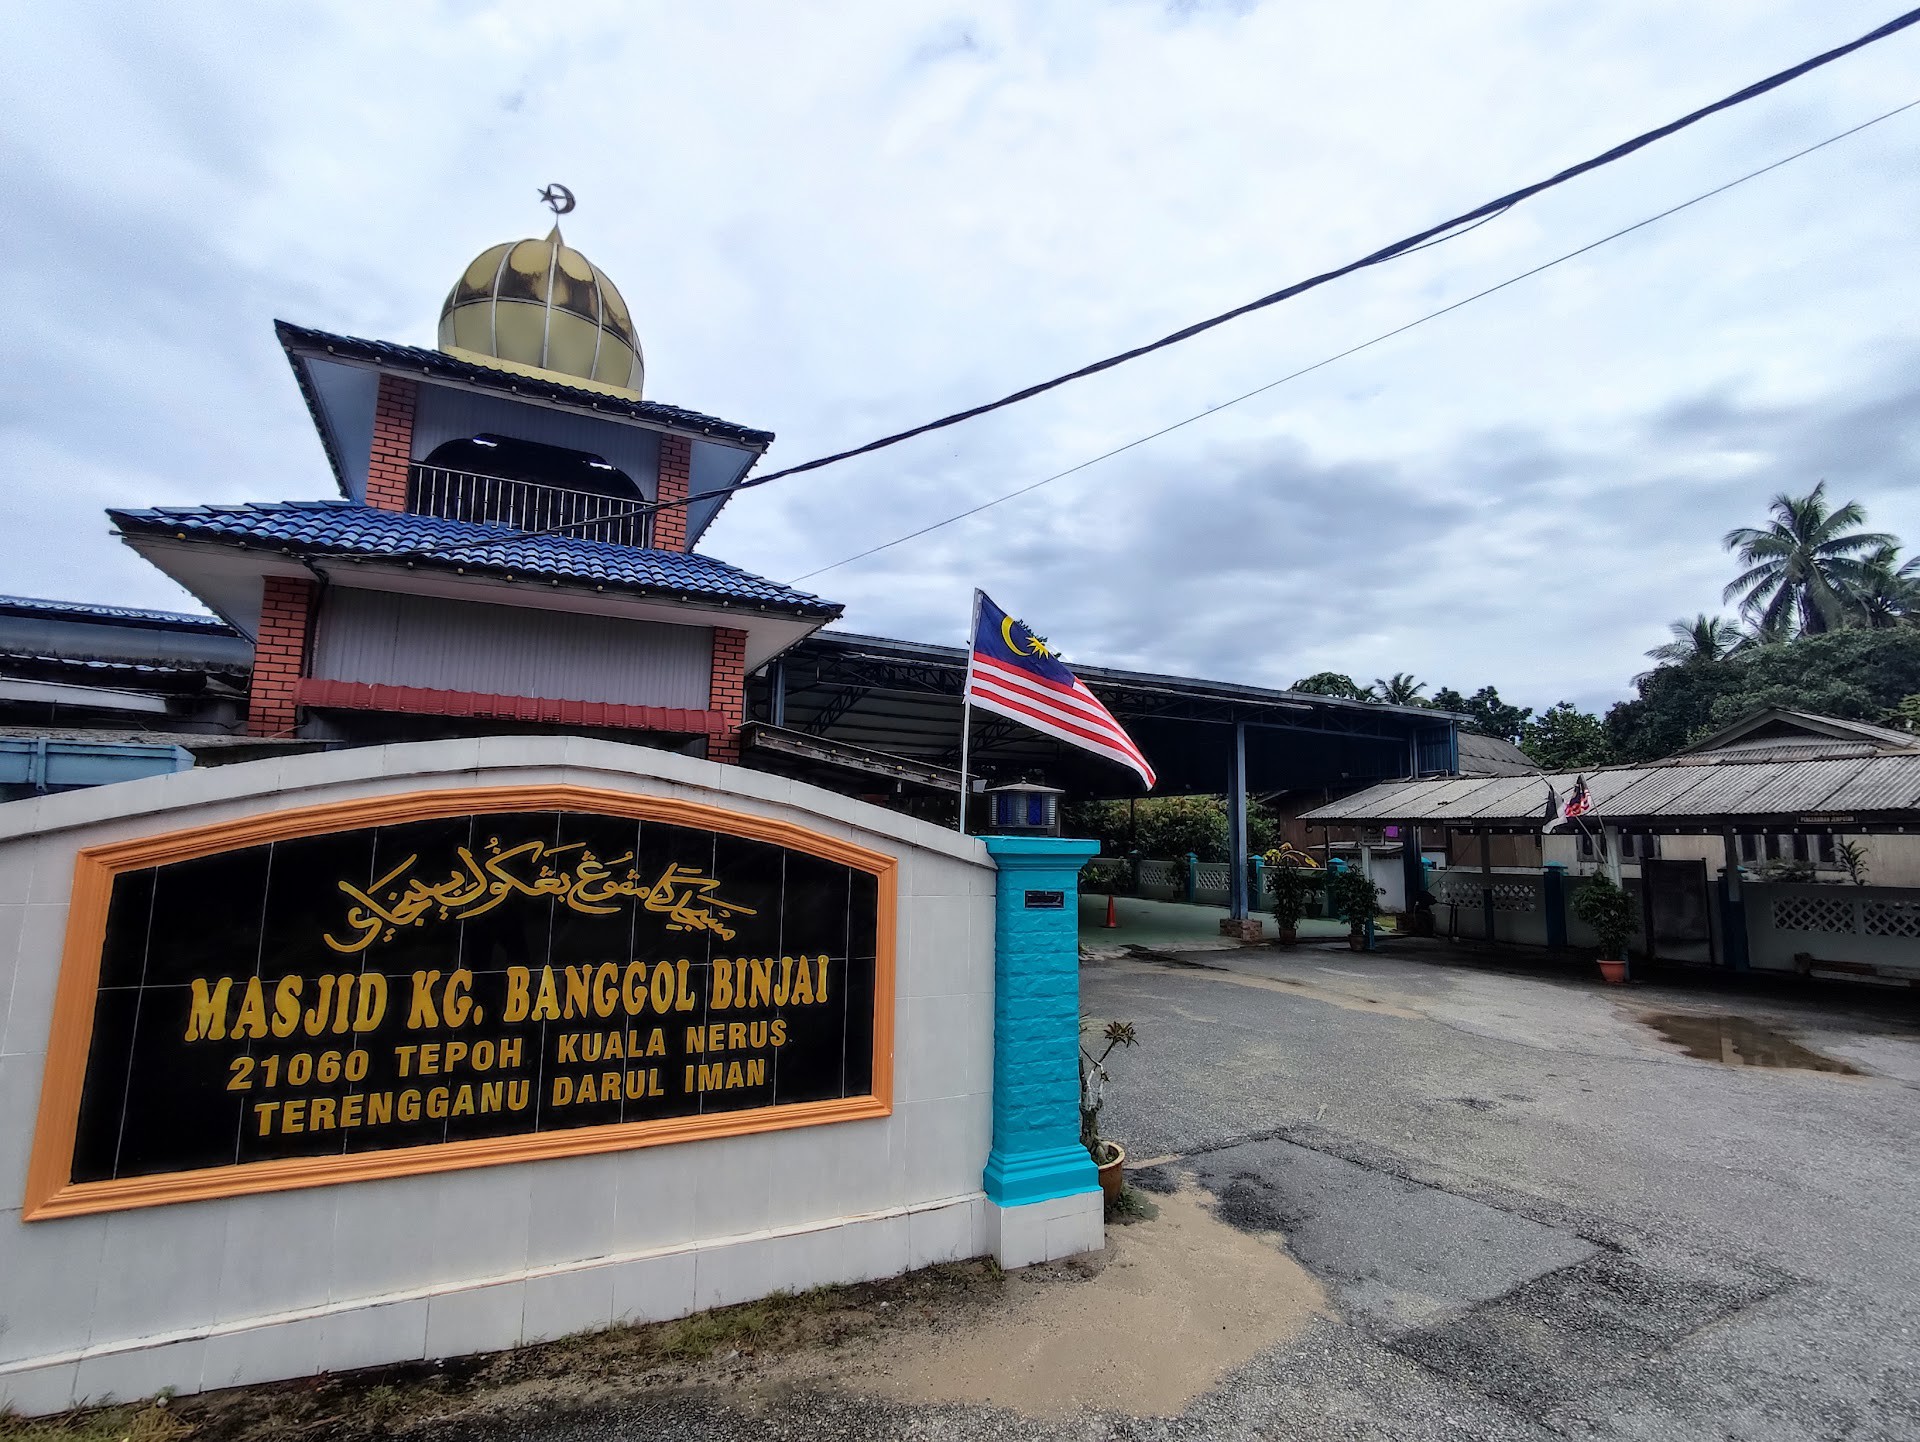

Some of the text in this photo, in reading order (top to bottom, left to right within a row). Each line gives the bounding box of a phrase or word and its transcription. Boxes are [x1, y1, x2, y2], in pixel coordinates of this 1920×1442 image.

[185, 955, 830, 1042] MASJID KG. BANGGOL BINJAI
[227, 1019, 787, 1091] 21060 TEPOH KUALA NERUS
[254, 1059, 765, 1136] TERENGGANU DARUL IMAN
